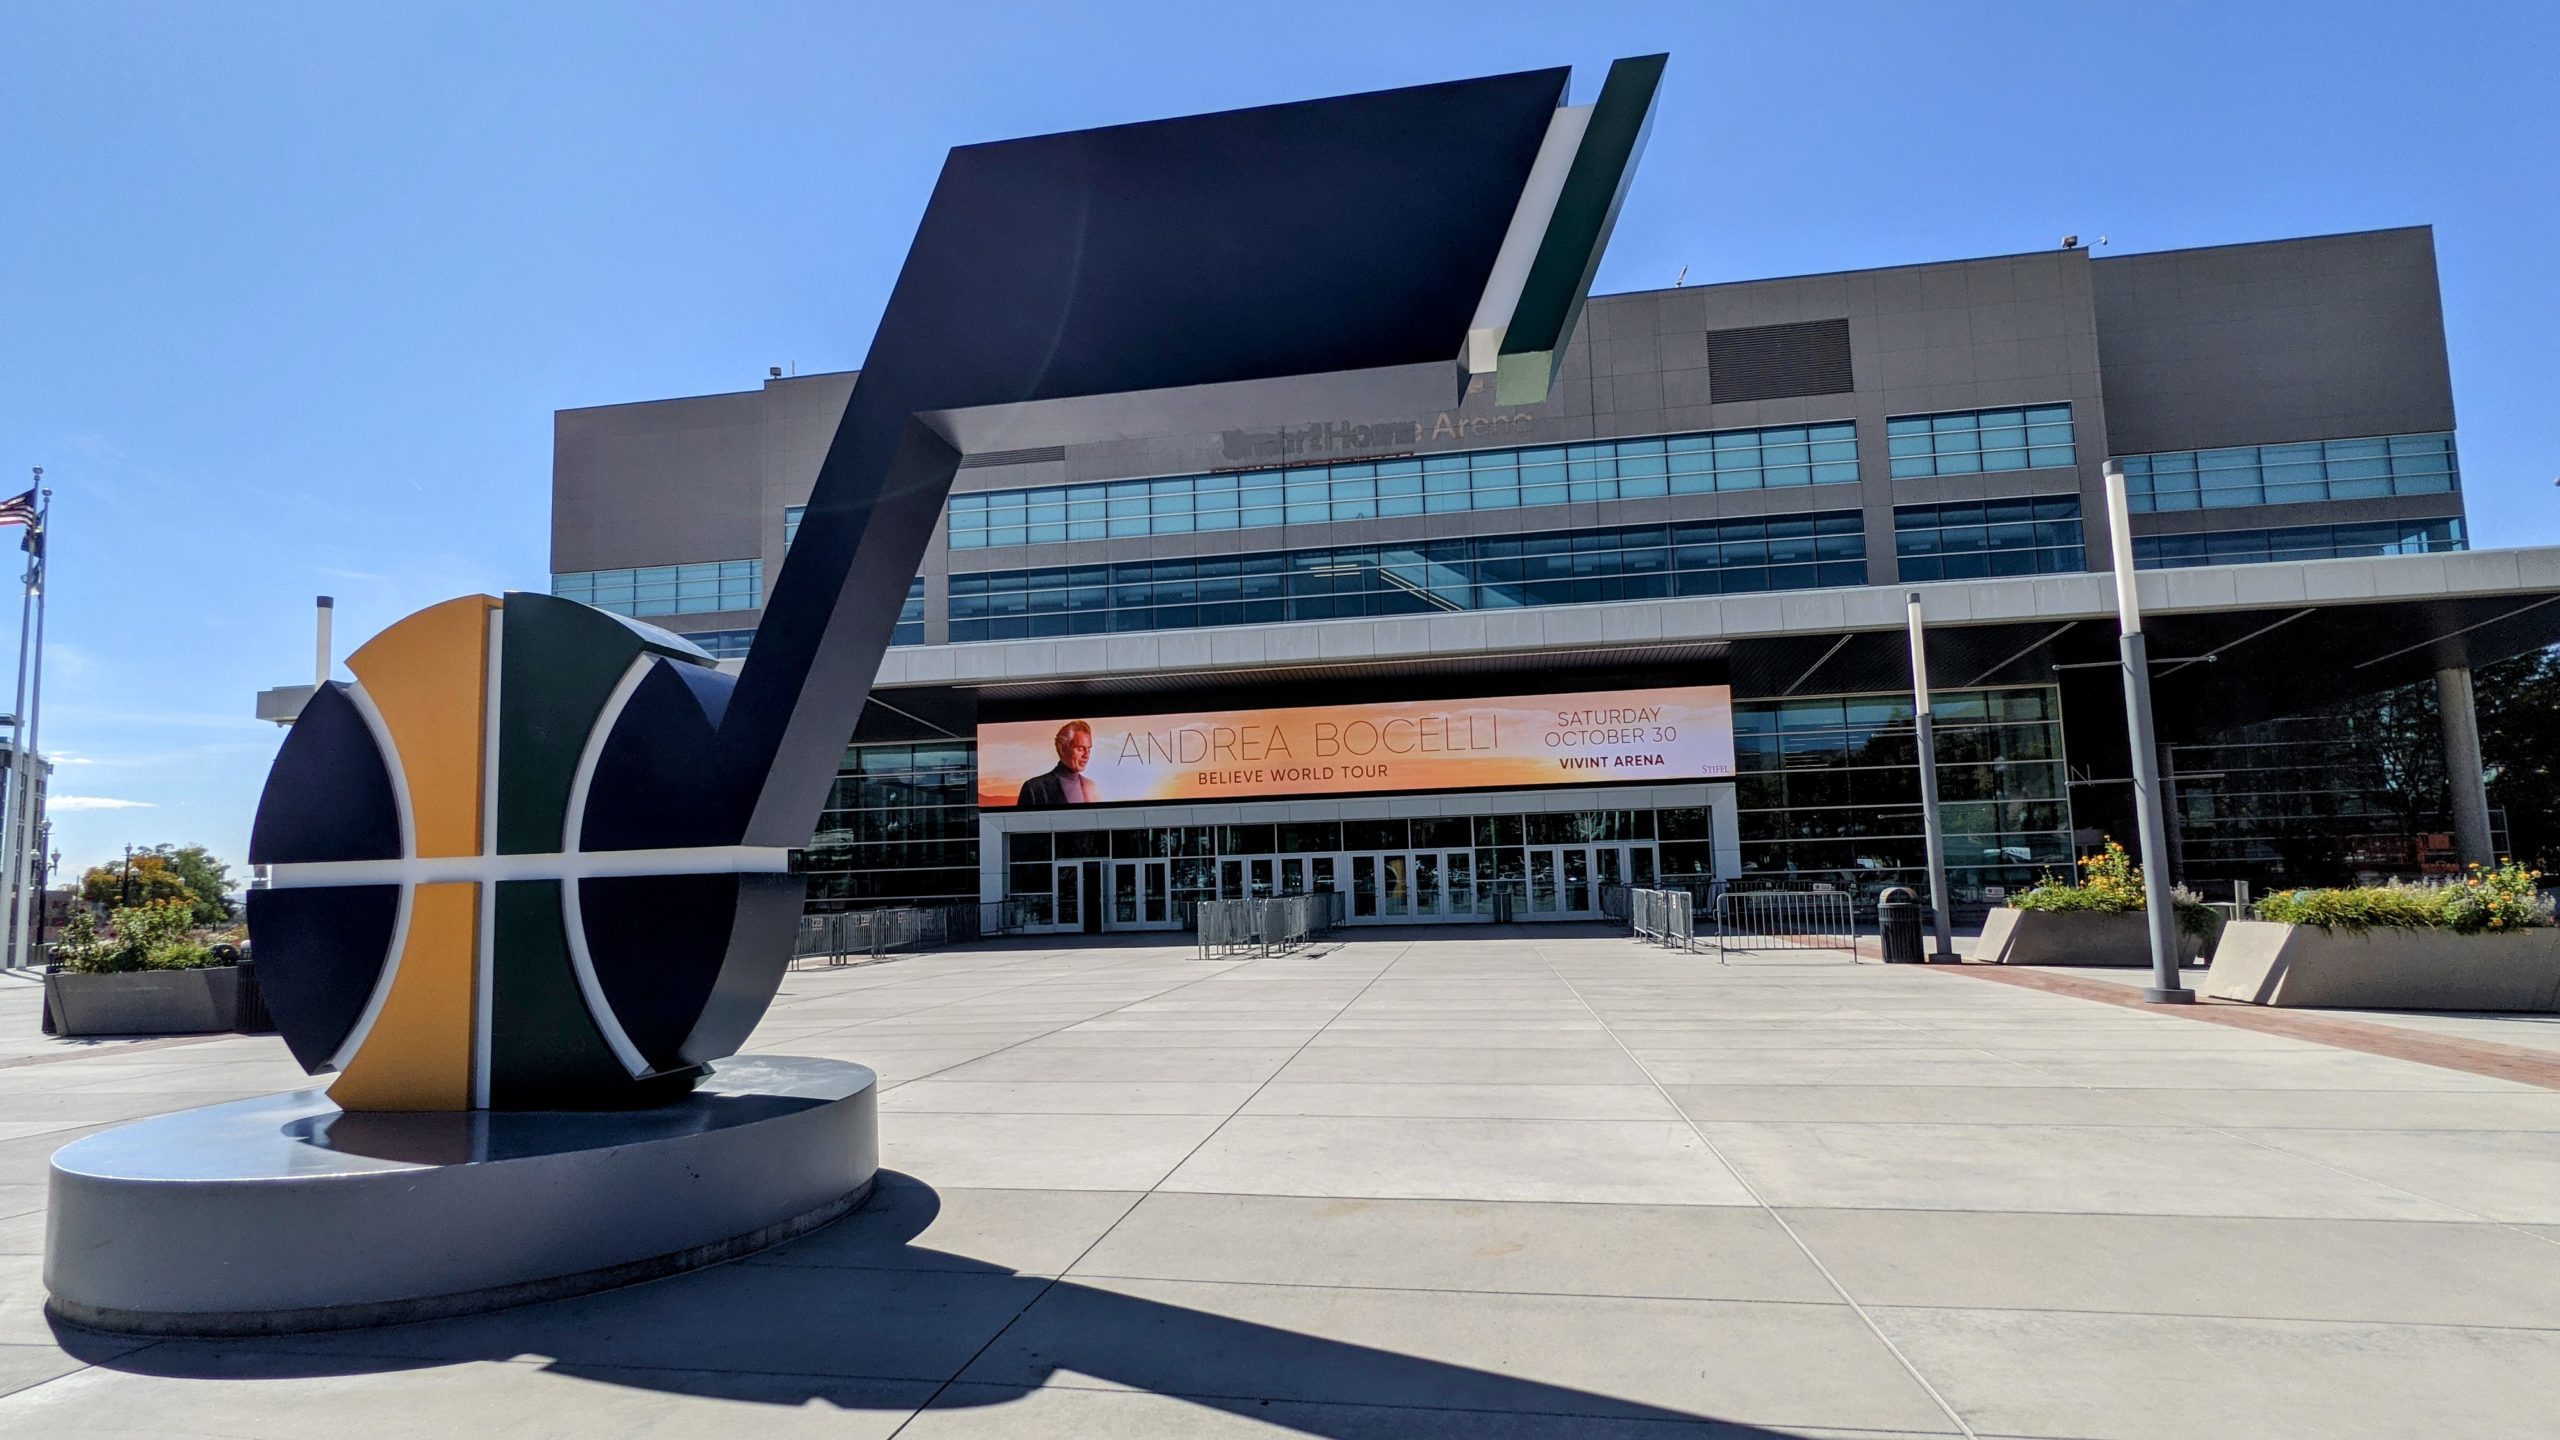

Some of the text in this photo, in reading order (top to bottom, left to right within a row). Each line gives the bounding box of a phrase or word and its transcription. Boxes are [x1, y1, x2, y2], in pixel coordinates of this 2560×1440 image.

[1557, 706, 1662, 728] SATURDAY
[1117, 713, 1498, 767] ANDREA BOCELLI
[1544, 726, 1677, 748] OCTOBER 30
[1559, 754, 1666, 770] VIVINT ARENA
[1198, 764, 1389, 785] BELIEVE WORLD TOUR
